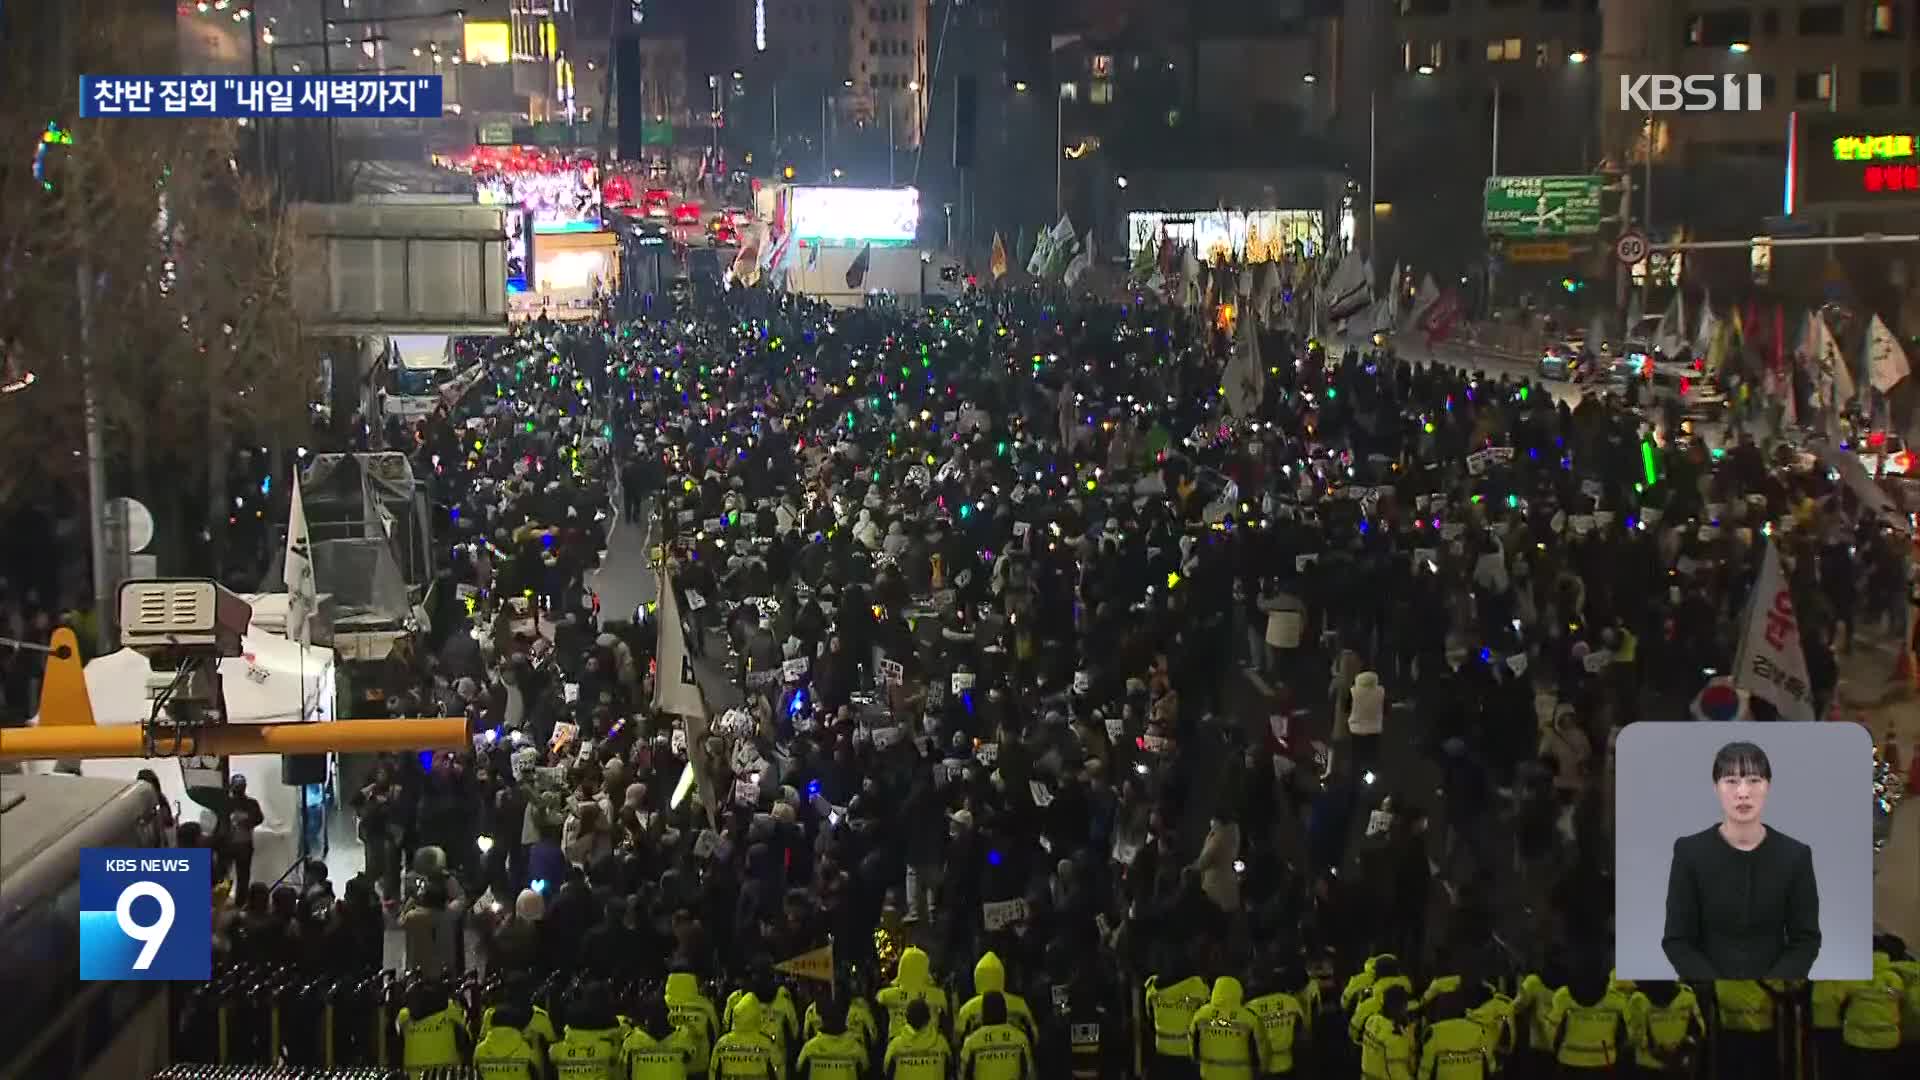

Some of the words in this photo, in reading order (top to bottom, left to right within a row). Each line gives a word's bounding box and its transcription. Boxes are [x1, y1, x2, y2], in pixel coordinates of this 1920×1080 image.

[1622, 241, 1641, 256] 60
[635, 1055, 674, 1064] POLICE
[721, 1055, 761, 1064] POLICE
